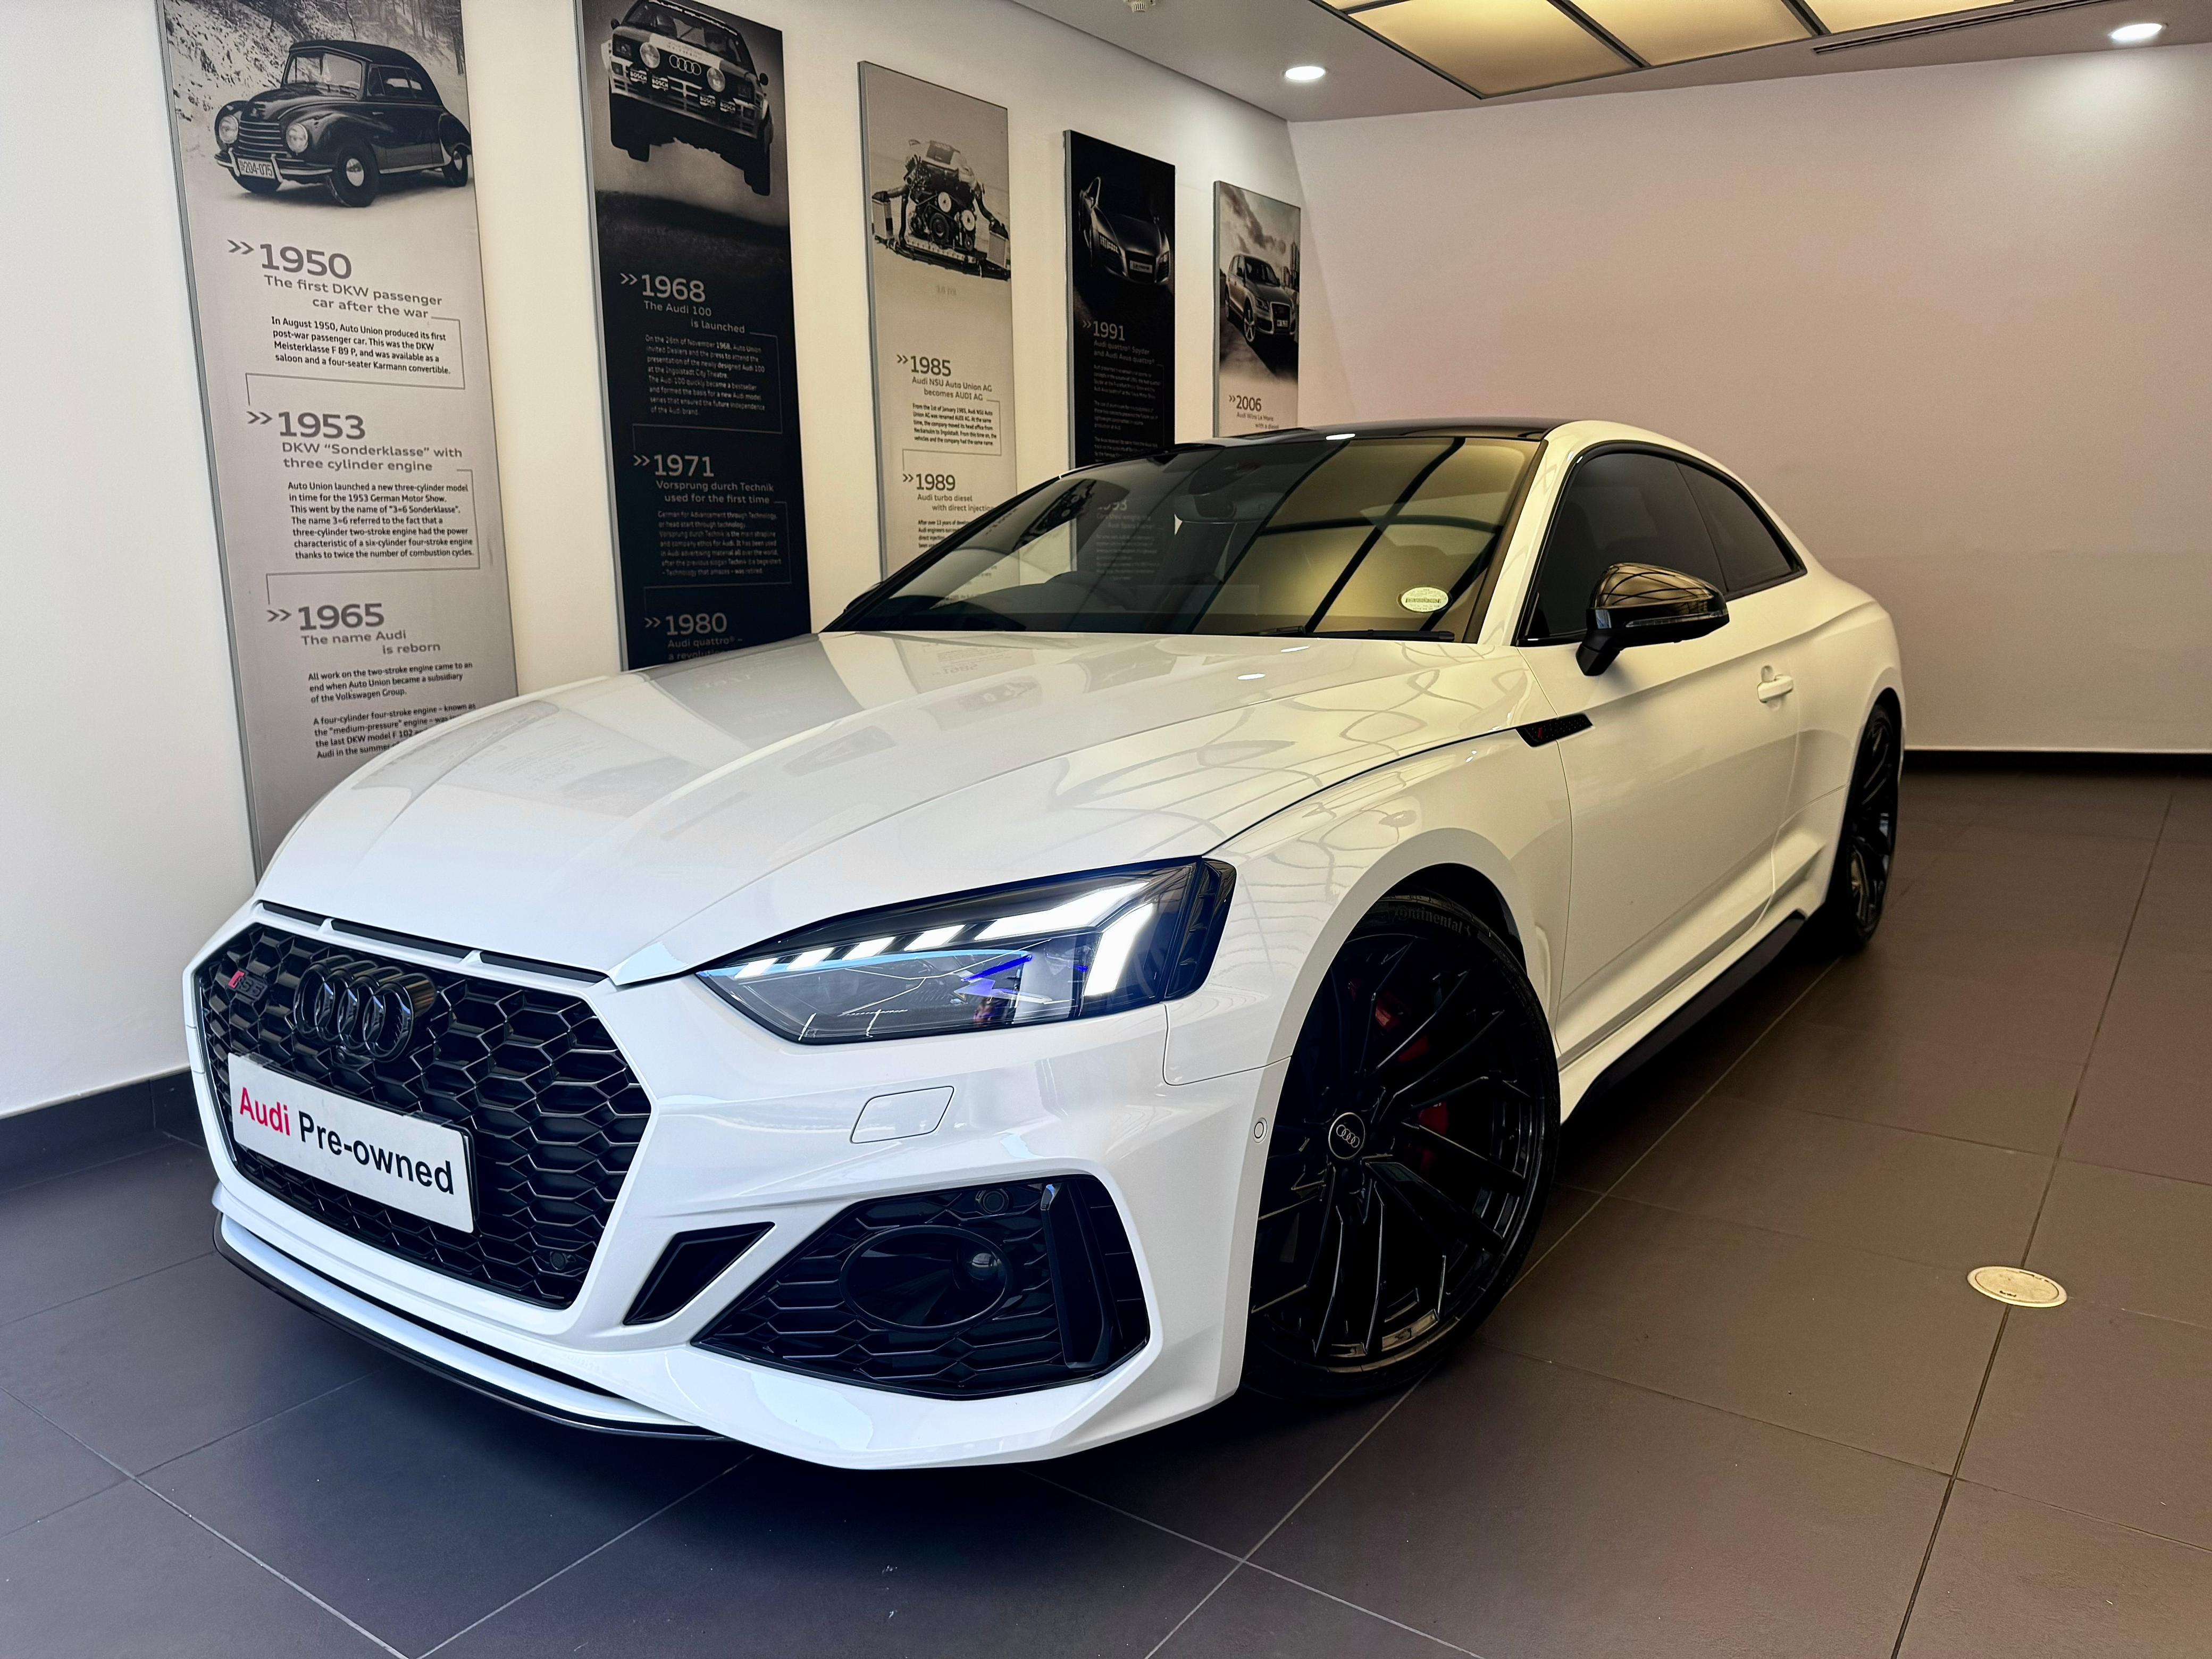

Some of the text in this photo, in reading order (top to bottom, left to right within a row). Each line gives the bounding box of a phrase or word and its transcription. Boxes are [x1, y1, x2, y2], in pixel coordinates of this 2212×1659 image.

[630, 71, 647, 81] BOSCH
[652, 79, 668, 89] BOSCH
[259, 243, 352, 280] 1950
[263, 274, 442, 306] The first DKW passenger
[641, 273, 706, 303] 1968
[312, 298, 429, 319] car after the war
[643, 299, 711, 317] The Audi 100
[271, 315, 446, 341] In August 1950, Auto Union produced its first
[690, 318, 745, 333] is launched
[1092, 320, 1125, 341] 1991
[272, 330, 309, 340] post-war
[311, 333, 351, 345] passenger
[367, 337, 384, 347] This
[401, 340, 414, 350] the
[415, 341, 434, 351] DKW
[273, 340, 330, 354] Meisterklasse
[331, 345, 336, 354] F
[359, 348, 374, 357] and
[391, 351, 424, 362] available
[274, 353, 303, 363] saloon
[304, 355, 320, 365] and
[328, 356, 371, 368] four-seater
[372, 361, 407, 371] Karmann
[910, 355, 951, 377] 1985
[911, 376, 927, 384] Audi
[929, 378, 943, 387] NSU
[945, 380, 961, 389] Auto
[962, 382, 981, 390] Union
[924, 388, 953, 398] becomes
[955, 391, 971, 400] AUDI
[1236, 395, 1262, 412] 2006
[278, 411, 366, 440] 1953
[281, 441, 320, 453] DKW
[433, 447, 462, 458] with
[282, 457, 432, 473] three cylinder engine
[653, 454, 714, 477] 1971
[287, 481, 308, 490] Auto
[308, 481, 333, 490] Union
[334, 481, 370, 491] launched
[394, 482, 444, 493] three-cylinder
[446, 483, 468, 492] model
[655, 480, 774, 492] Vorsprung durch Technik
[915, 473, 956, 491] 1989
[288, 492, 297, 501] in
[298, 492, 318, 502] time
[319, 492, 331, 502] for
[332, 493, 346, 502] the
[348, 493, 368, 502] 1953
[370, 493, 400, 502] German
[401, 494, 423, 502] Motor
[664, 492, 770, 504] used for the first time
[289, 504, 307, 514] This
[308, 505, 329, 514] went
[330, 504, 340, 515] by
[341, 504, 355, 514] the
[379, 504, 388, 514] of
[297, 602, 384, 631] 1965
[665, 611, 727, 635] 1980
[300, 629, 406, 646] The name Audi
[667, 638, 690, 648] Audi
[382, 642, 441, 655] is reborn
[307, 672, 320, 681] All
[320, 670, 341, 680] work
[352, 669, 366, 677] the
[367, 665, 408, 676] two-stroke
[408, 665, 433, 674] engine
[308, 682, 324, 693] end
[325, 681, 347, 691] when
[348, 680, 367, 689] Auto
[368, 678, 391, 688] Union
[391, 676, 420, 685] became
[310, 693, 319, 703] of
[320, 693, 334, 703] the
[334, 690, 381, 701] Volkswagen
[239, 1087, 455, 1196] Audi Pre-owned
